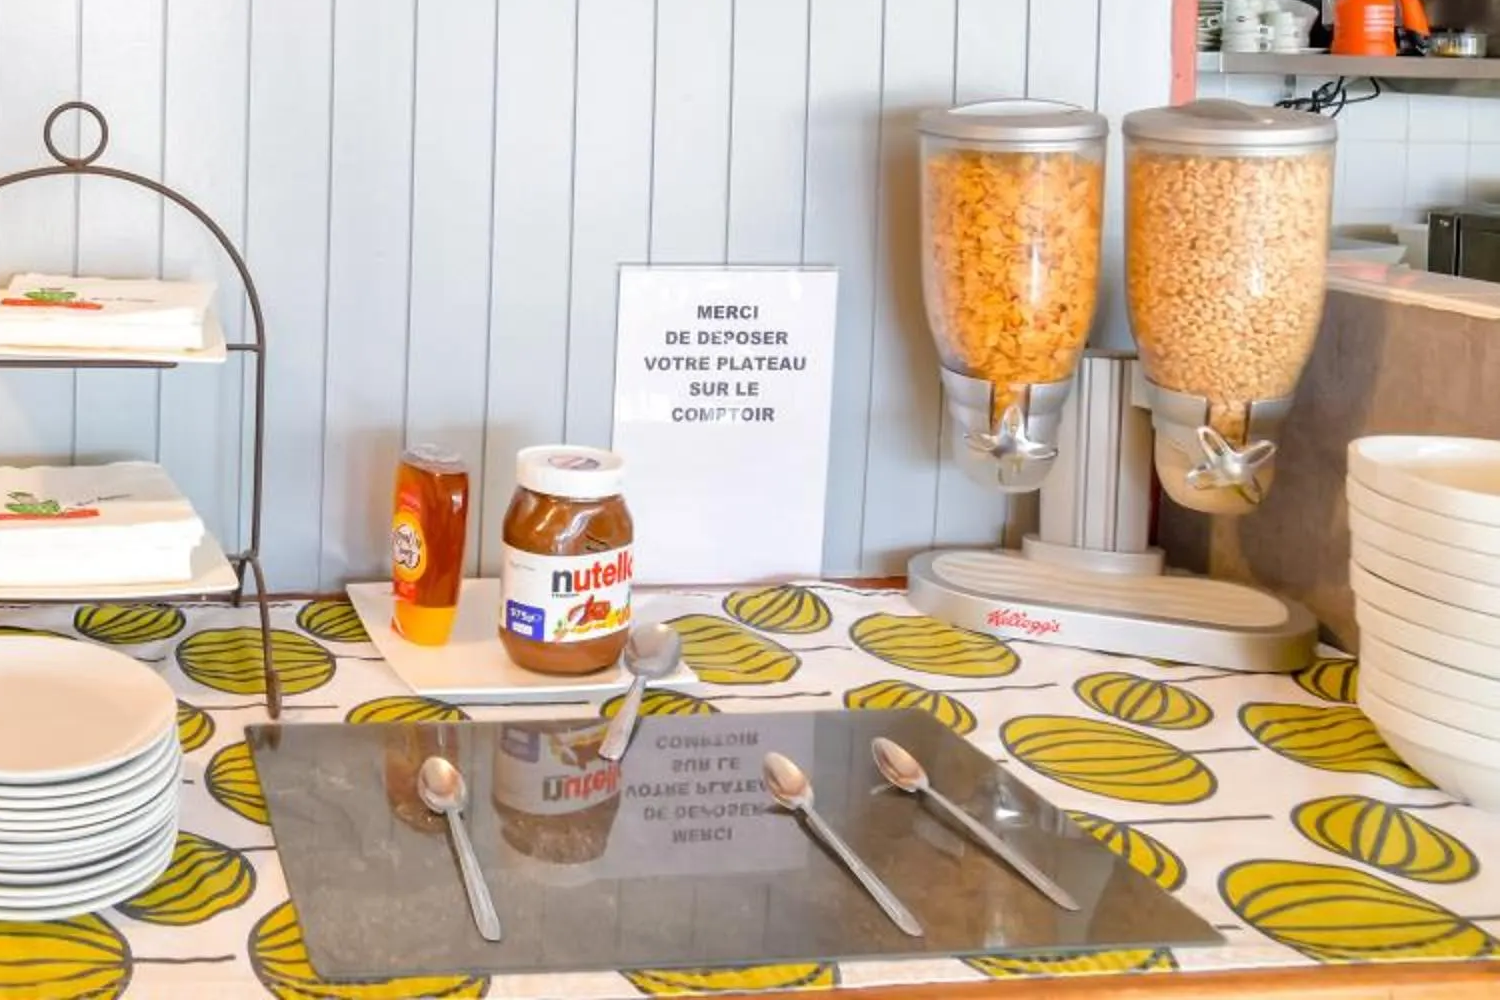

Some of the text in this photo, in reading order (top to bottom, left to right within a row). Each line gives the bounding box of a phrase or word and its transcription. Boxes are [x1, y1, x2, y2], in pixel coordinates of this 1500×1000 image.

[697, 304, 759, 320] MERCI
[665, 330, 789, 345] DE DEPOSER
[644, 356, 807, 371] VOTRE PLATEAU
[689, 381, 759, 397] SUR LE
[671, 407, 775, 422] COMPTOIR
[985, 608, 1061, 636] Kellogg's
